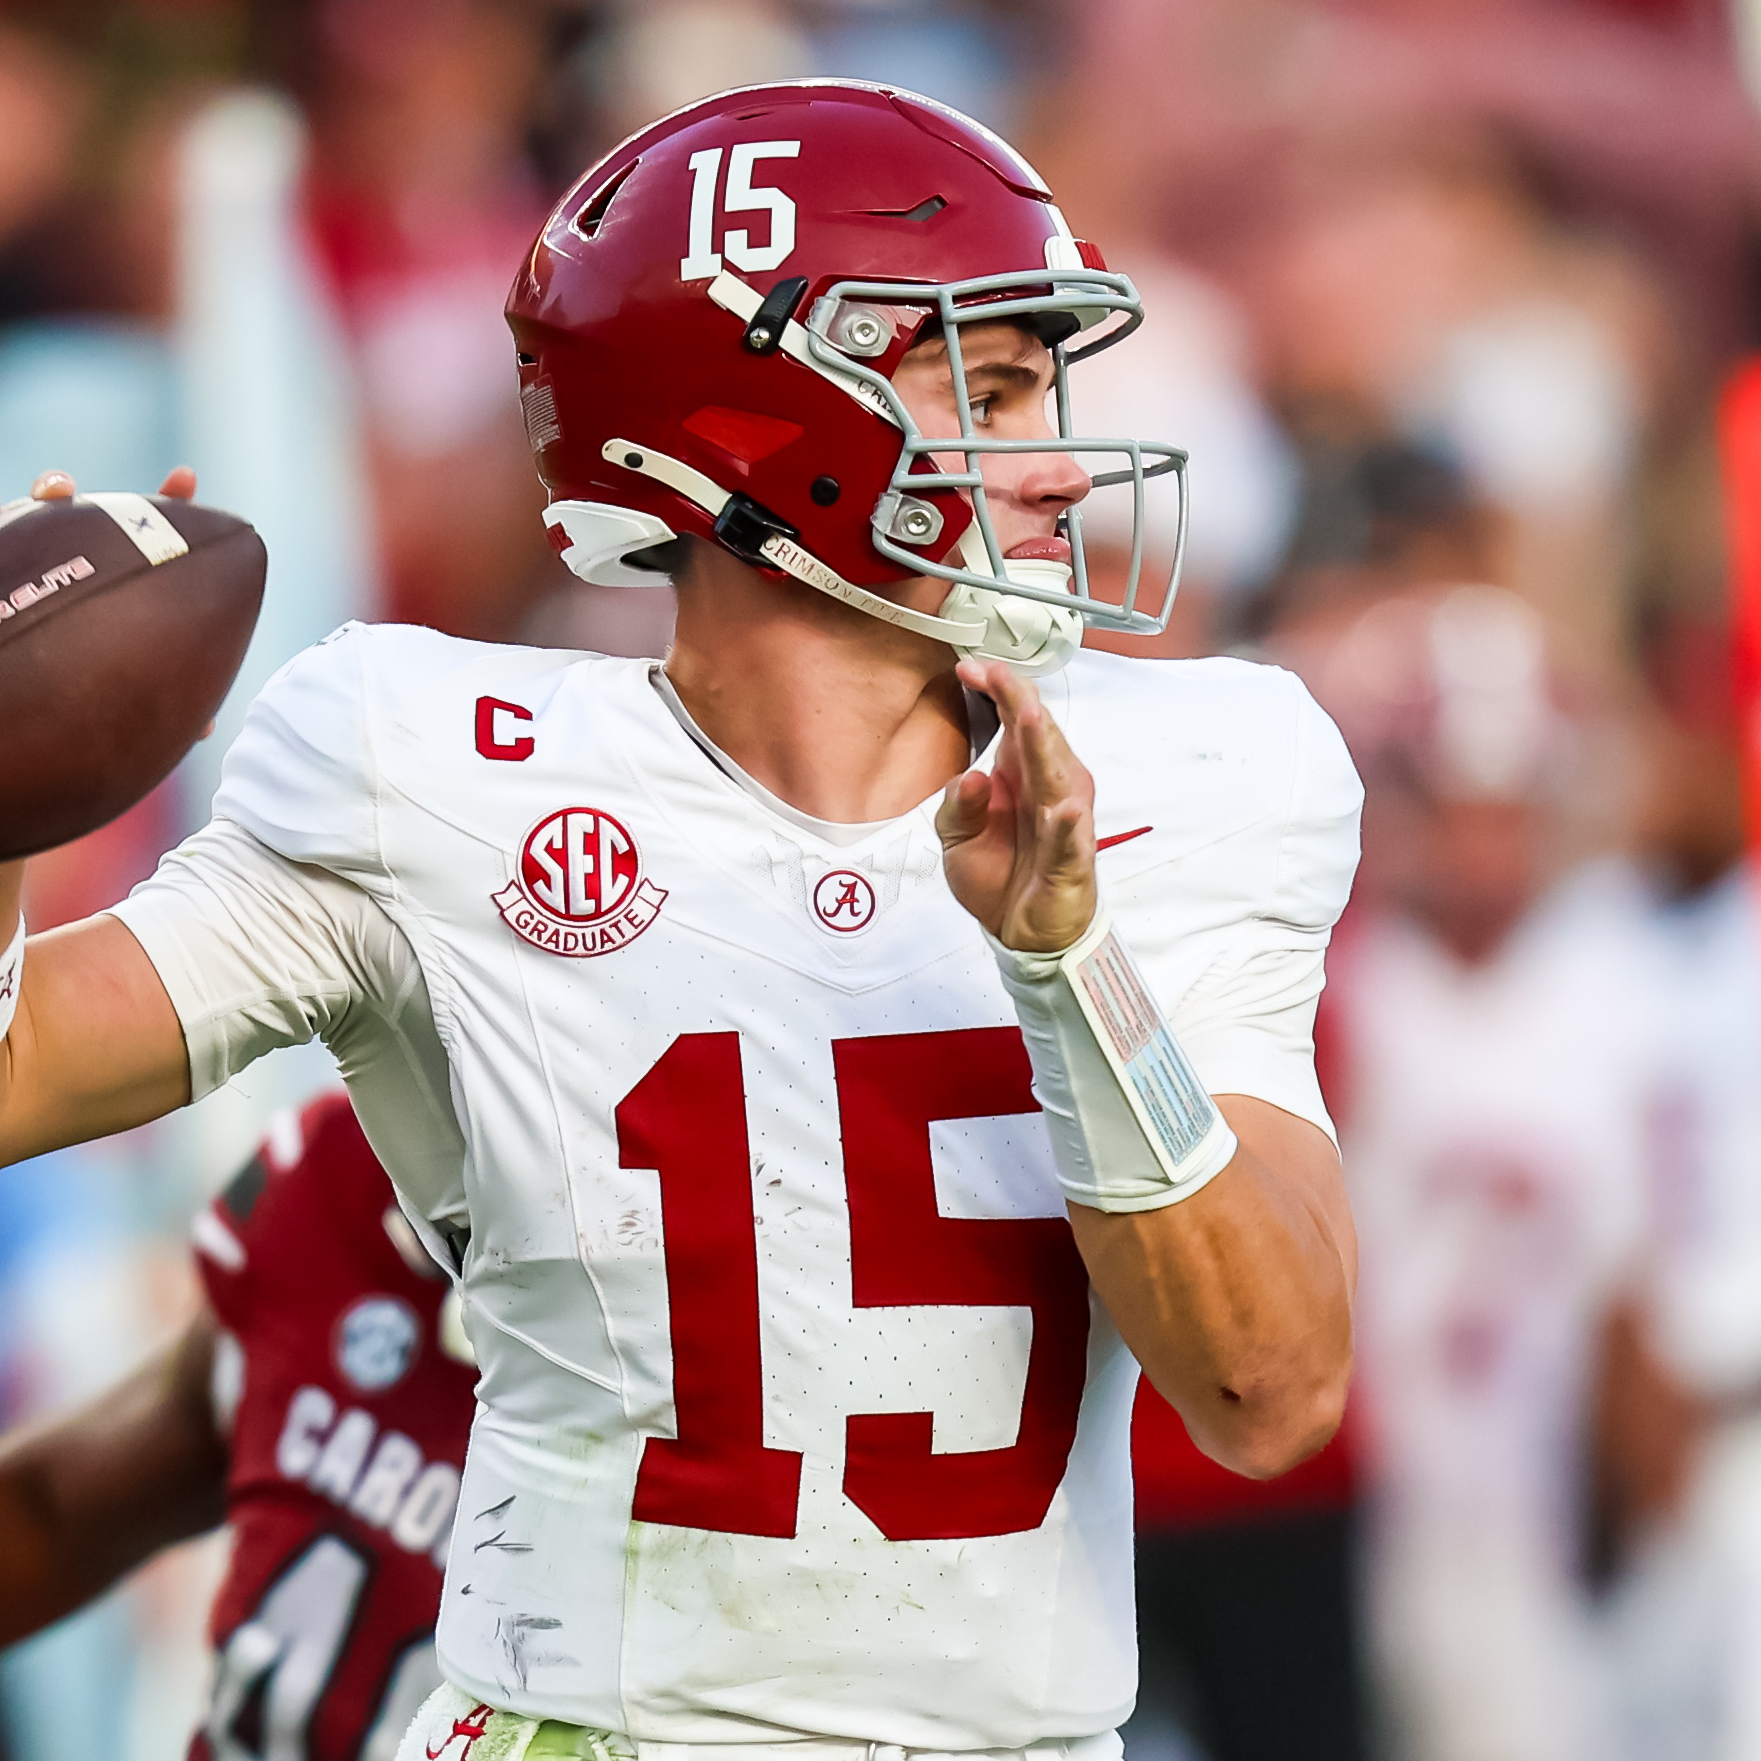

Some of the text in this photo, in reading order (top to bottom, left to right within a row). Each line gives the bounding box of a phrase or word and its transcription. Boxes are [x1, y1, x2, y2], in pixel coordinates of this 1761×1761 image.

[681, 140, 801, 281] 15
[475, 696, 535, 761] C
[529, 812, 631, 916] SEC
[823, 880, 862, 917] A
[515, 908, 645, 952] GRADUATE
[615, 1026, 1091, 1542] 15
[276, 1384, 461, 1572] CARO
